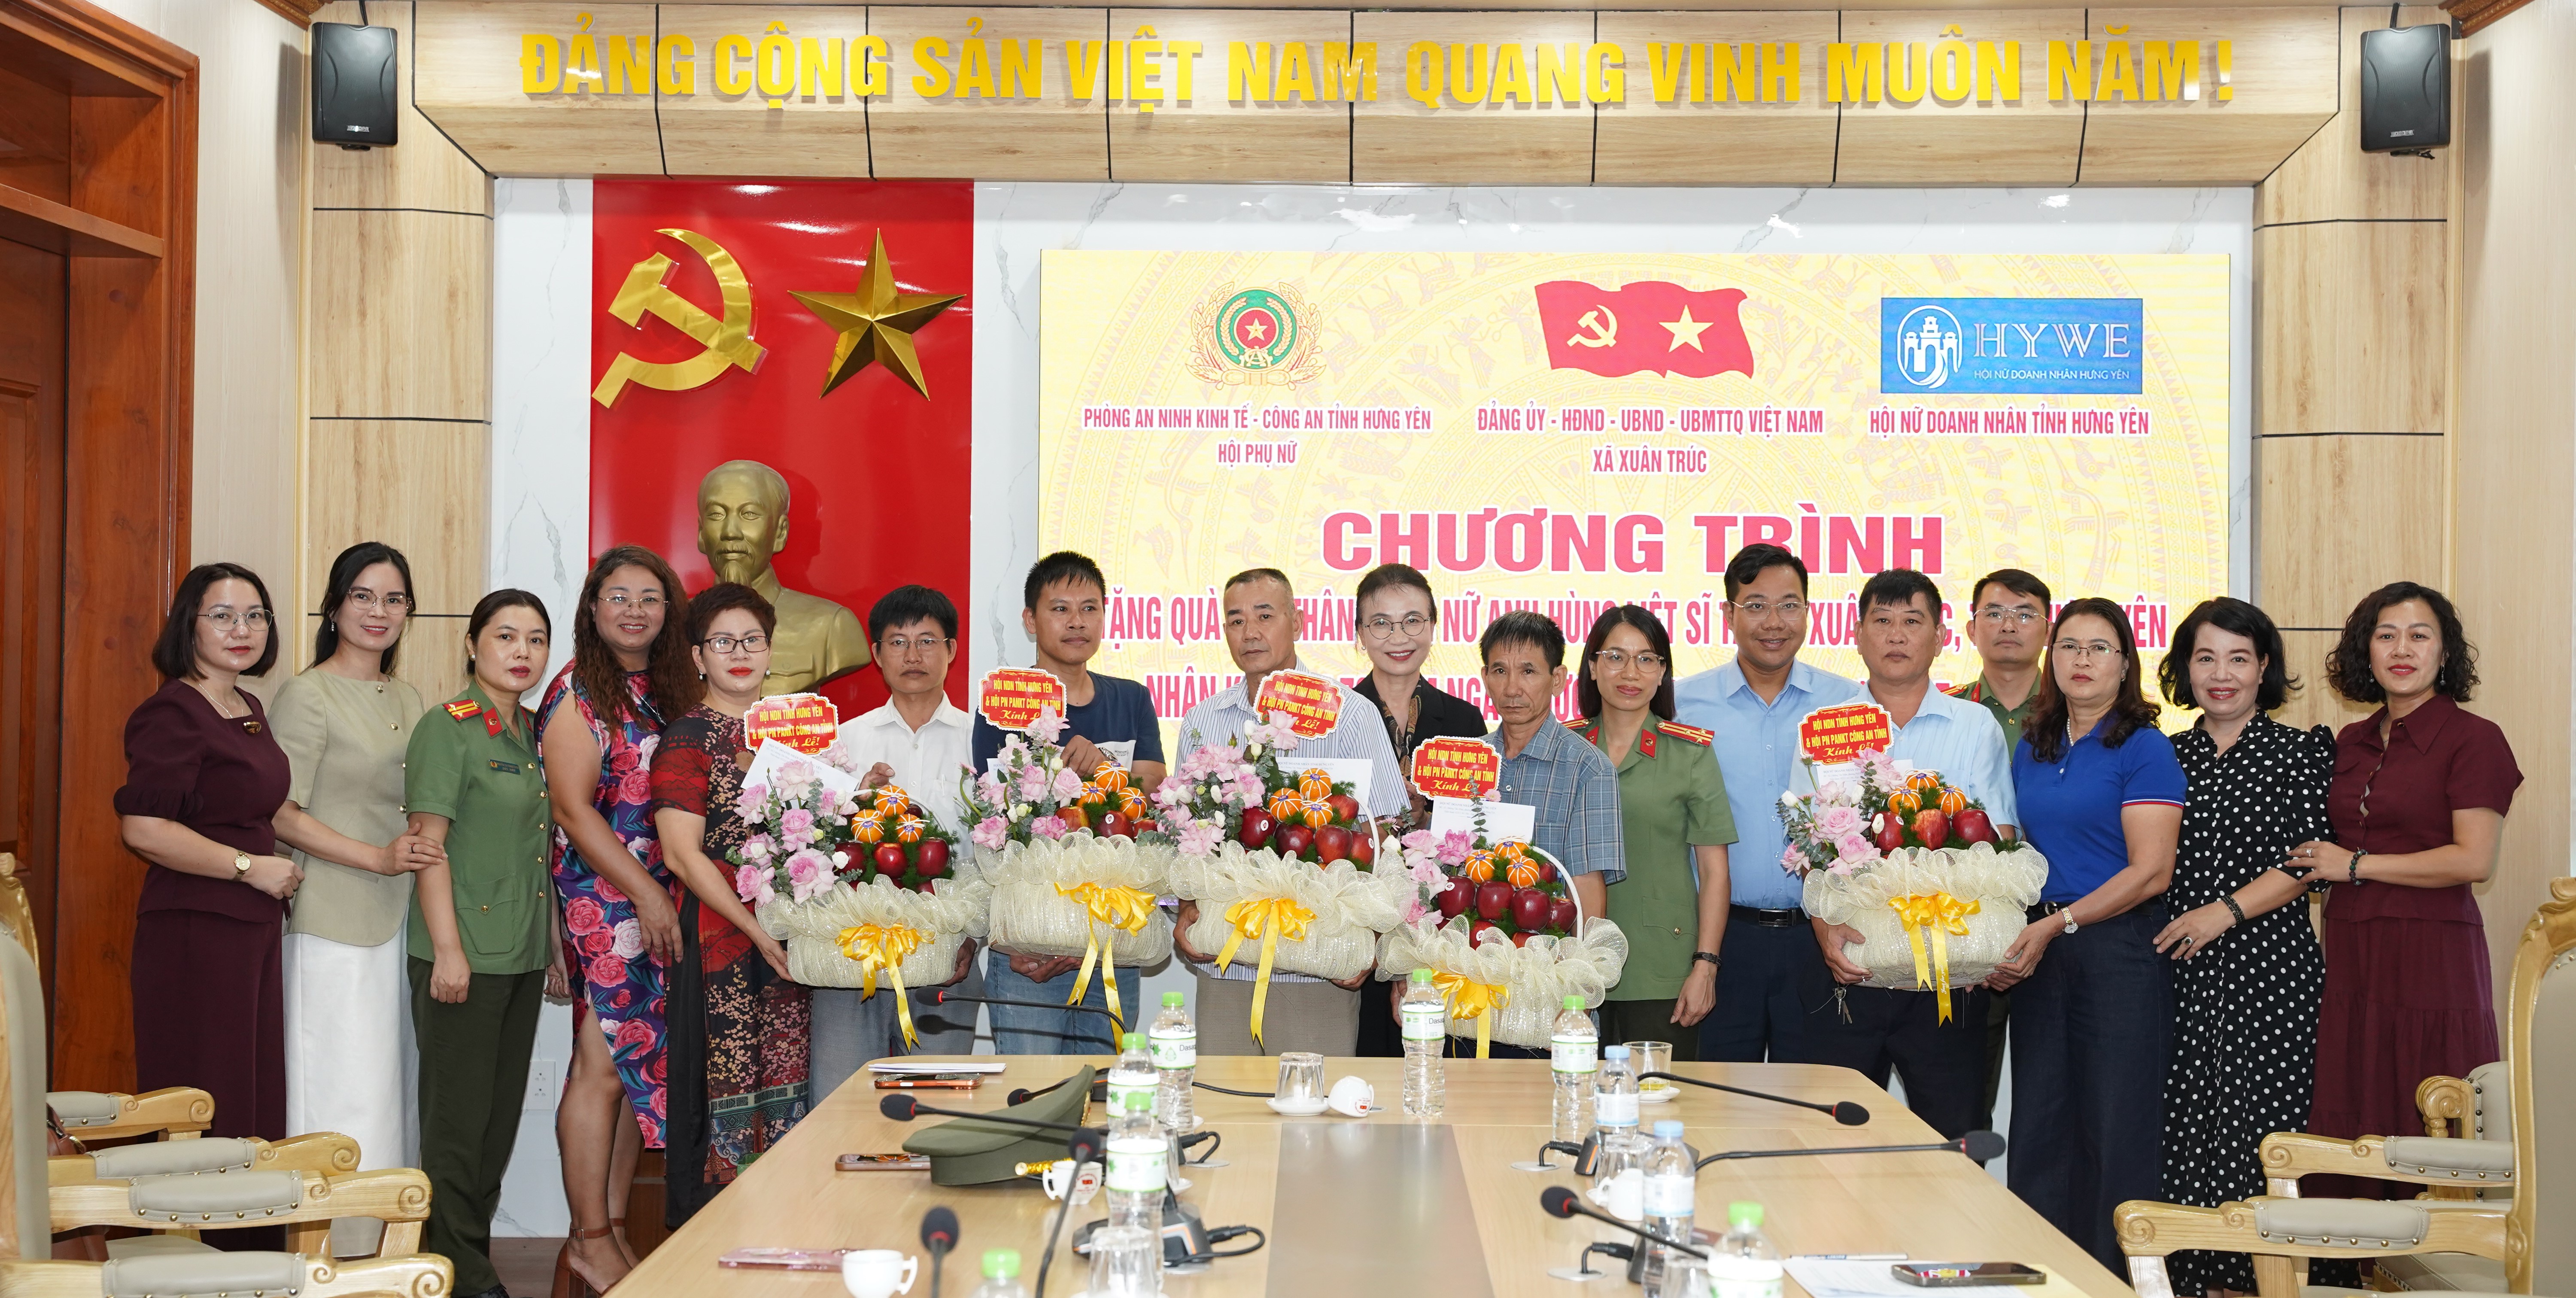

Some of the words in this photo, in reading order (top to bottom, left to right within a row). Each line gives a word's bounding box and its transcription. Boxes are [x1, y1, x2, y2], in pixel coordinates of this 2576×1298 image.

[520, 12, 695, 95] ĐẢNG
[715, 21, 887, 109] CỘNG
[912, 17, 1042, 98] SẢN
[1065, 25, 1203, 112] VIỆT
[1228, 42, 1377, 101] NAM
[1406, 40, 1625, 109] QUANG
[1646, 42, 1800, 102] VINH
[1827, 24, 2020, 103] MUÔN
[1974, 323, 2130, 358] HYWE
[1974, 368, 1992, 380] HỘI
[1994, 368, 2010, 379] NỮ
[2011, 369, 2047, 379] DOANH
[2049, 368, 2078, 379] NHÂN
[2079, 369, 2108, 380] HƯNG
[2111, 368, 2129, 380] YÊN
[1084, 403, 1130, 428] PHÒNG
[1136, 409, 1153, 428] AN
[1159, 409, 1191, 428] NINH
[1197, 410, 1228, 428] KINH
[1234, 401, 1249, 428] TẾ
[1263, 403, 1299, 429] CÔNG
[1305, 410, 1323, 429] AN
[1328, 402, 1358, 429] TỈNH
[1364, 408, 1400, 429] HƯNG
[1406, 404, 1430, 429] YÊN
[1478, 401, 1520, 431] ĐẢNG
[1527, 401, 1545, 431] ỦY
[1562, 409, 1604, 431] HĐND
[1622, 410, 1663, 432] UBND
[1681, 410, 1743, 435] UBMTTQ
[1749, 406, 1781, 437] VIỆT
[1787, 410, 1823, 433] NAM
[1871, 406, 1895, 438] HỘI
[1901, 407, 1923, 434] NỮ
[1927, 411, 1978, 434] DOANH
[1984, 407, 2026, 434] NHÂN
[2032, 403, 2067, 434] TỈNH
[2072, 409, 2114, 434] HƯNG
[2120, 407, 2149, 435] YÊN
[1218, 439, 1240, 466] HỘI
[1246, 444, 1272, 468] PHỤ
[1278, 440, 1297, 463] NỮ
[1593, 447, 1614, 472] XÃ
[1619, 446, 1662, 472] XUÂN
[1667, 446, 1707, 473] TRÚC
[1324, 508, 1664, 573] CHƯƠNG
[1171, 587, 1221, 645] QUÀ
[1443, 591, 1481, 643] NỮ
[1549, 591, 1616, 644] HÙN
[1686, 593, 1711, 644] SĨ
[1809, 593, 1858, 645] XUÂ
[993, 678, 1002, 692] HỘI
[1003, 681, 1014, 691] NDN
[1015, 678, 1027, 692] TỈNH
[1028, 681, 1041, 693] HƯNG
[1042, 681, 1052, 693] YÊN
[1274, 681, 1283, 694] HỘI
[1284, 683, 1295, 695] NDN
[1295, 683, 1308, 697] TỈNH
[1307, 688, 1322, 701] HƯNG
[1321, 691, 1333, 703] YÊN
[986, 696, 990, 706] &
[991, 694, 999, 708] HỘI
[1001, 697, 1008, 707] PN
[1009, 697, 1025, 708] PANKT
[1027, 696, 1040, 709] CÔNG
[1262, 696, 1267, 705] &
[1267, 695, 1277, 709] HỘI
[1276, 698, 1285, 710] PN
[1284, 700, 1302, 714] PANKT
[1301, 703, 1316, 717] CÔNG
[1314, 708, 1324, 719] AN
[1323, 707, 1336, 722] TỈNH
[759, 709, 769, 723] HỘI
[770, 709, 782, 720] NDN
[796, 707, 811, 718] HƯNG
[812, 705, 823, 717] YÊN
[1813, 718, 1823, 733] HỘI
[1823, 718, 1835, 729] NDN
[1836, 714, 1849, 727] TỈNH
[1849, 715, 1865, 726] HƯNG
[1865, 712, 1876, 724] YÊN
[752, 730, 757, 739] &
[769, 727, 776, 738] PN
[777, 726, 794, 737] PANKT
[796, 723, 811, 736] CÔNG
[812, 724, 820, 734] AN
[820, 719, 833, 733] TỈNH
[1806, 738, 1810, 748] &
[1811, 735, 1821, 749] HỘI
[1822, 735, 1830, 745] PN
[1831, 733, 1848, 745] PANKT
[1850, 730, 1865, 742] CÔNG
[1865, 730, 1874, 740] AN
[1874, 725, 1887, 739] TỈNH
[1428, 747, 1437, 762] HỘI
[1437, 750, 1449, 761] NDN
[1450, 748, 1462, 762] TỈNH
[1462, 751, 1477, 762] HƯNG
[1478, 751, 1488, 764] YÊN
[1823, 746, 1853, 757] Kính
[1417, 766, 1422, 776] &
[1423, 764, 1432, 778] HỘI
[1432, 766, 1440, 778] PN
[1441, 767, 1458, 779] PANKT
[1474, 769, 1482, 781] AN
[1482, 767, 1494, 782] TỈNH
[1430, 780, 1460, 791] Kính
